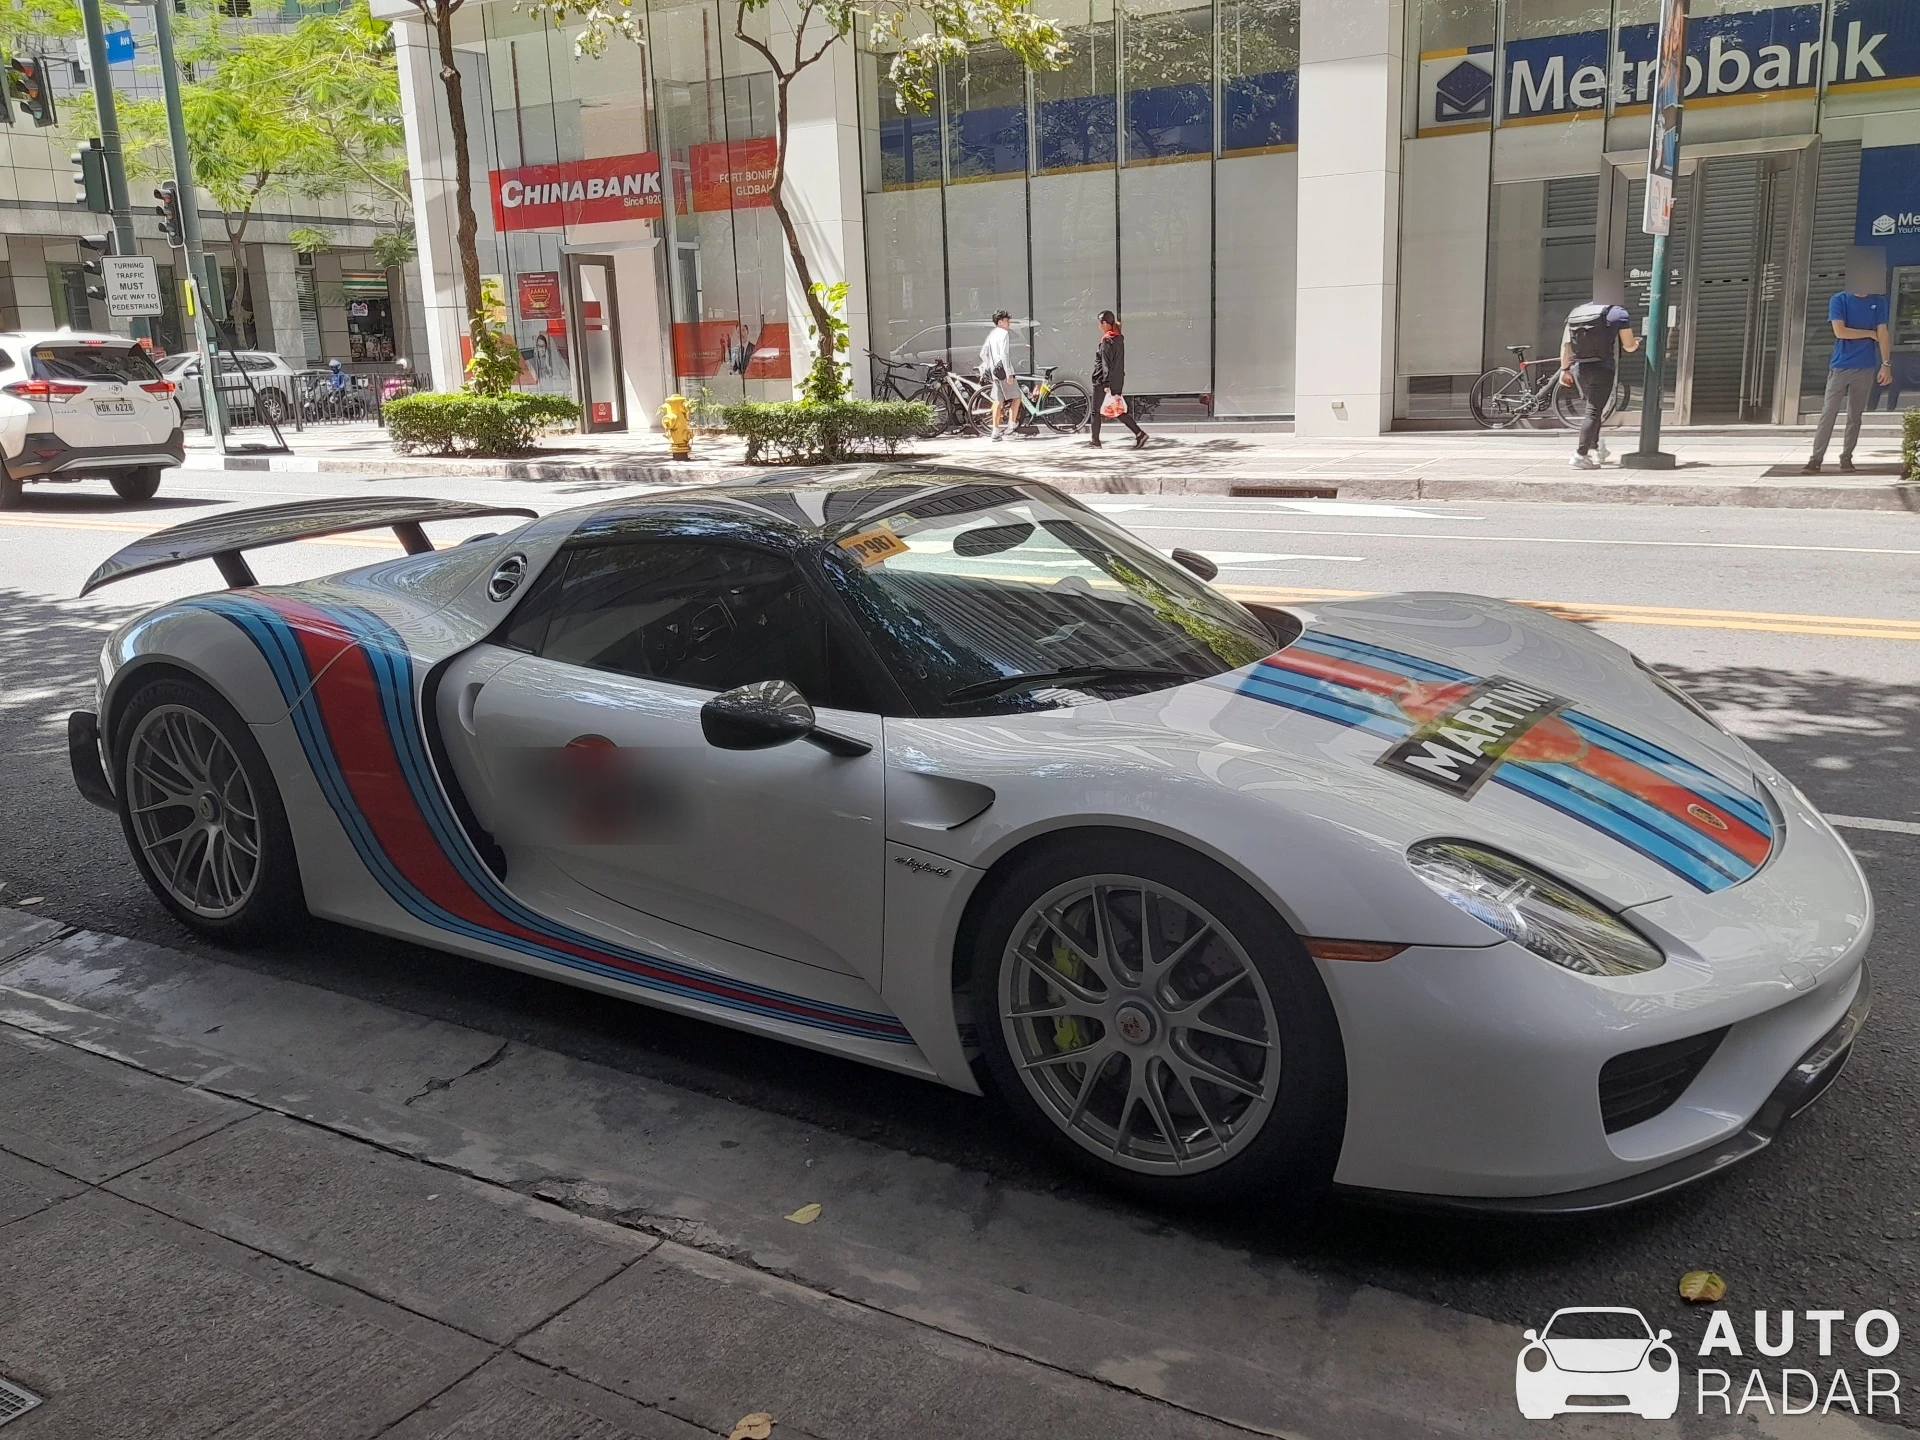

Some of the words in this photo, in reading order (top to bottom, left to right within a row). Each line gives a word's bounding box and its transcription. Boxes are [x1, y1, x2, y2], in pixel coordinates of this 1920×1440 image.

[120, 36, 130, 47] Ave
[719, 172, 744, 184] FORT
[501, 171, 661, 208] CHINABANK
[623, 197, 644, 207] Since
[113, 262, 145, 270] TURNING
[119, 282, 144, 291] MUST
[111, 302, 159, 311] PEDESTRIANS
[852, 534, 897, 559] P987
[1404, 681, 1556, 783] MARTINI
